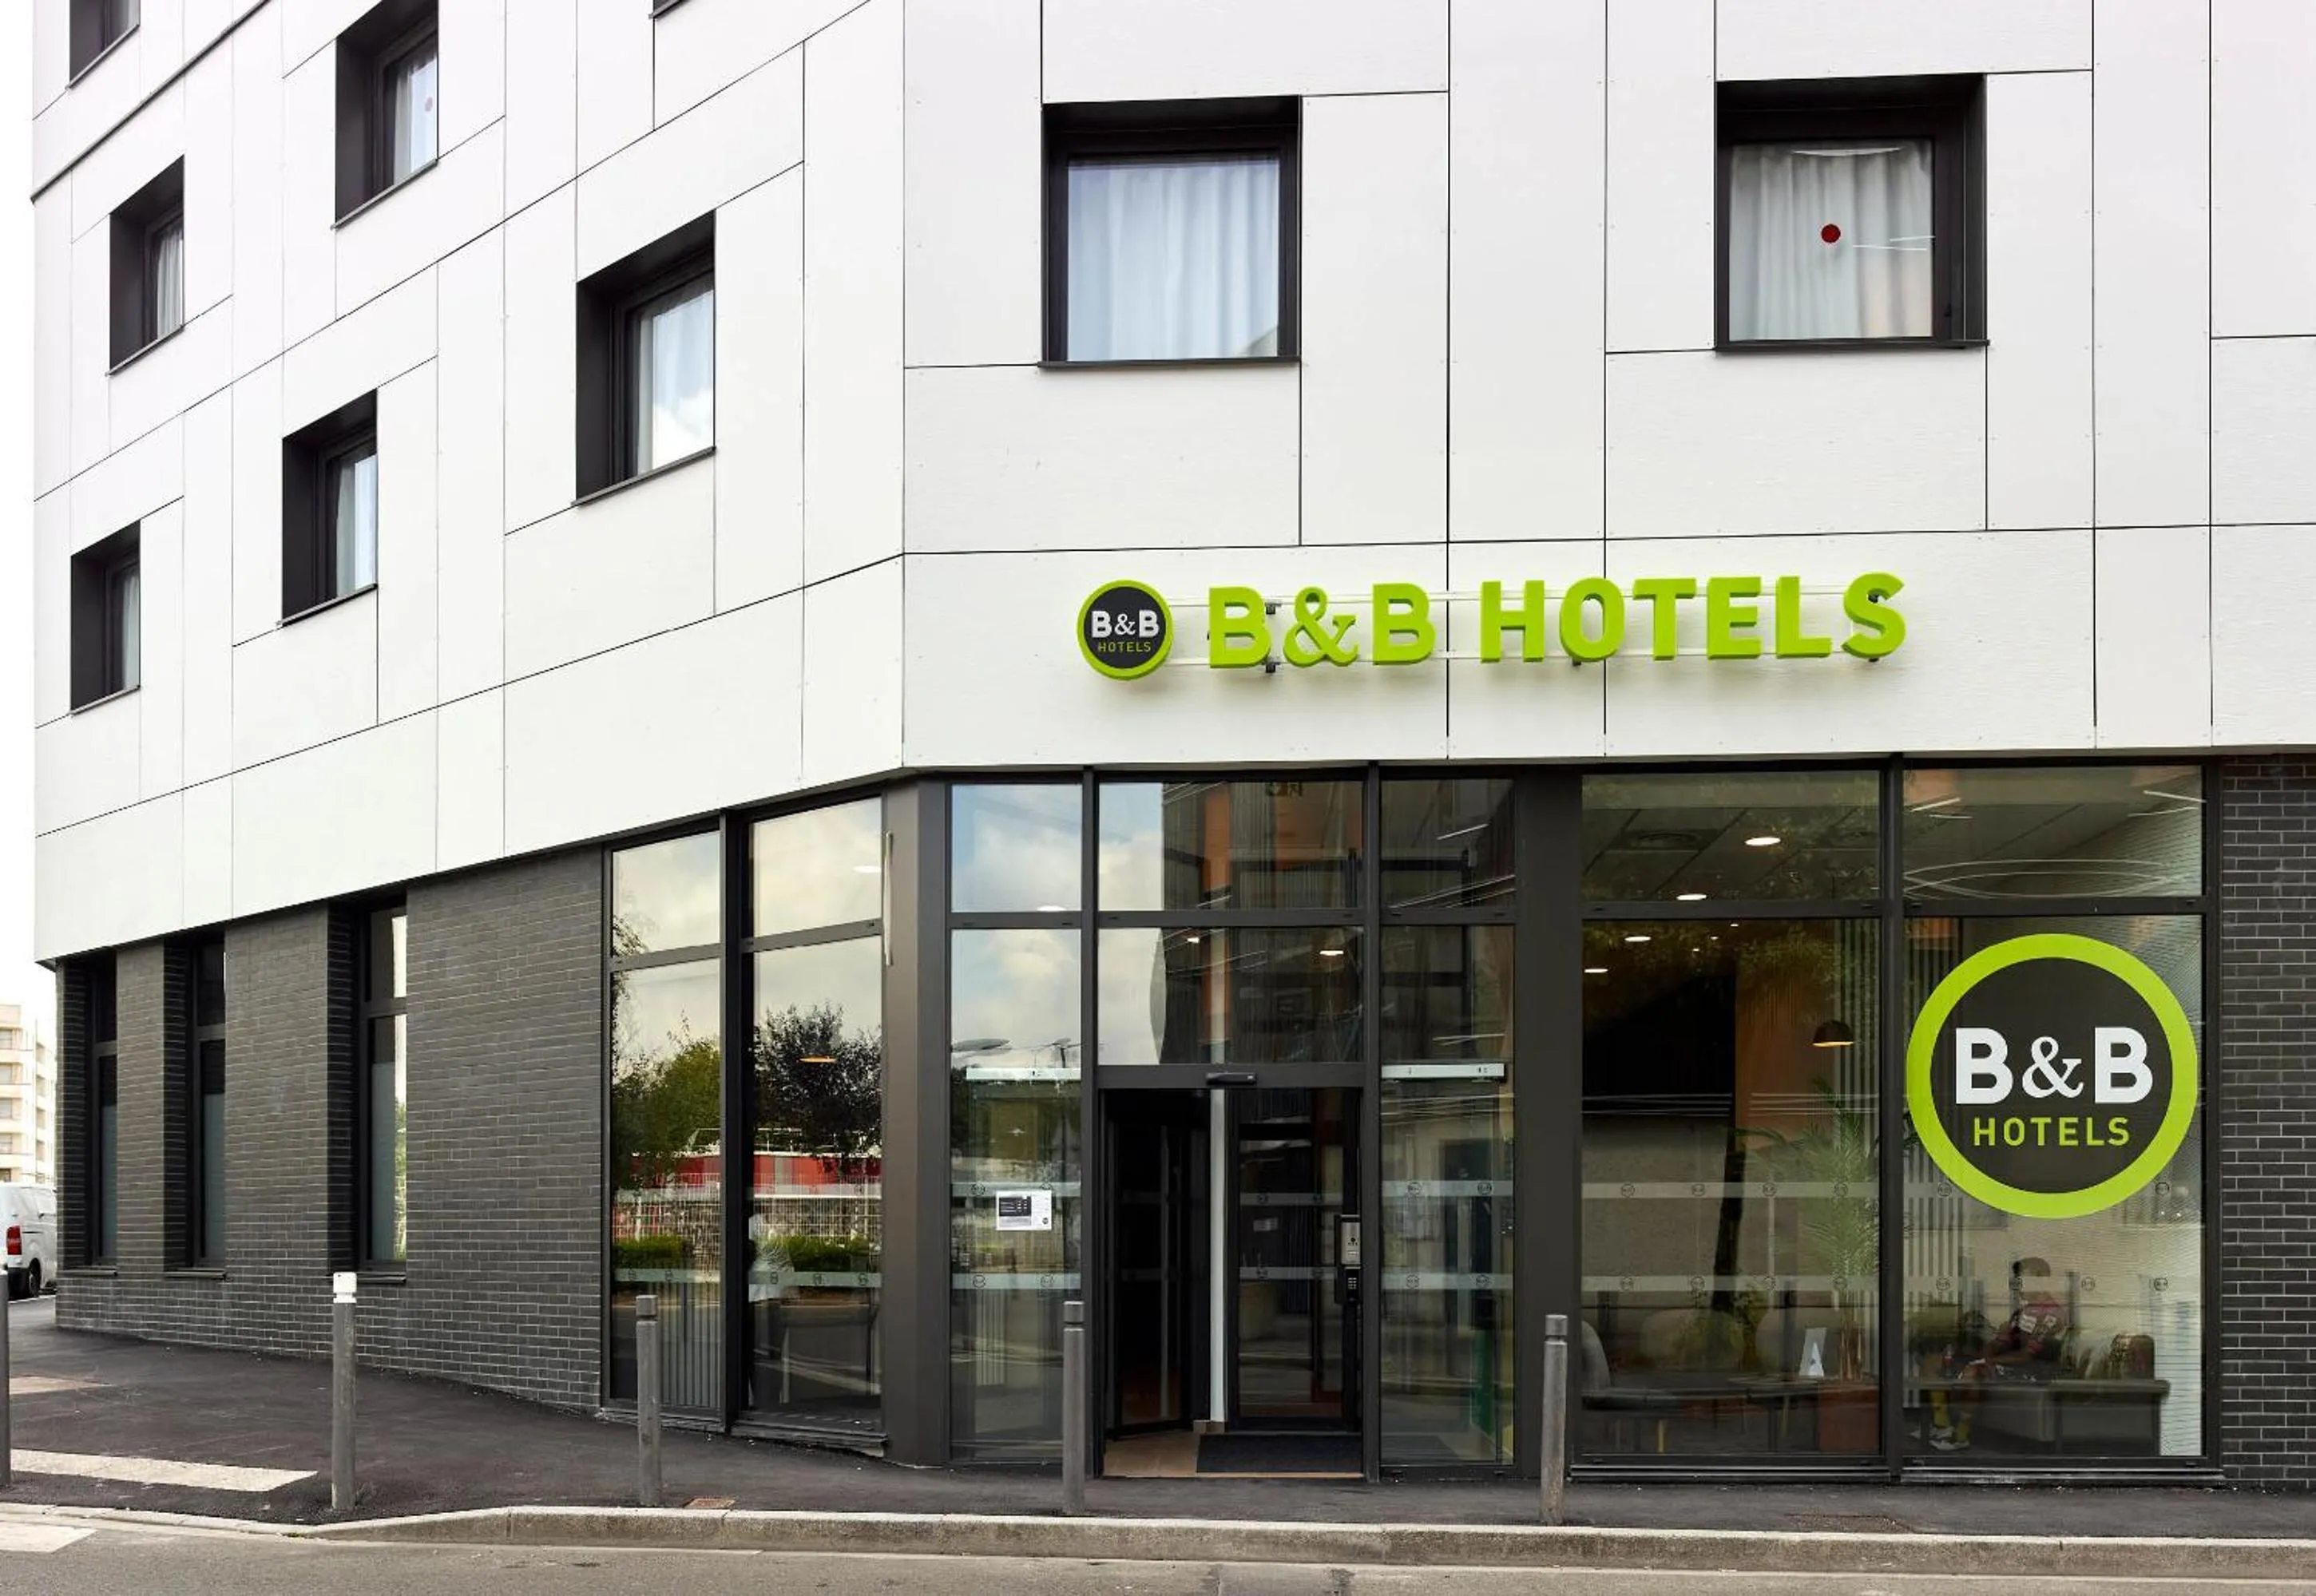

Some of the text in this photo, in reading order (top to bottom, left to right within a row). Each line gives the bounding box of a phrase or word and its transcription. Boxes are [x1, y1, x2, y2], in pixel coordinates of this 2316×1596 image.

[1091, 609, 1160, 638] B&B
[1208, 572, 1907, 668] B&B HOTELS
[1098, 641, 1152, 653] HOTELS
[1955, 1027, 2154, 1104] B&B
[1973, 1117, 2130, 1147] HOTELS
